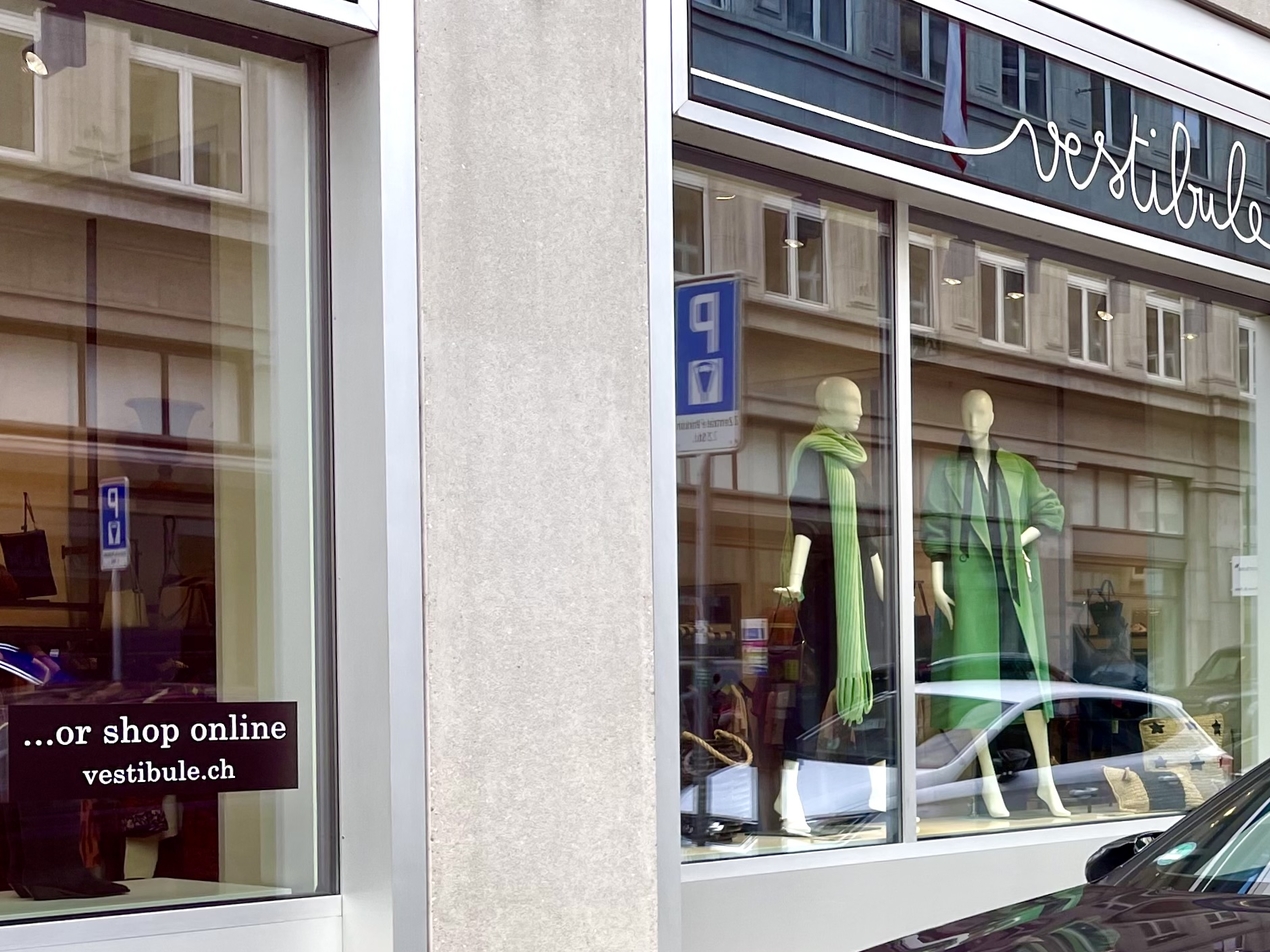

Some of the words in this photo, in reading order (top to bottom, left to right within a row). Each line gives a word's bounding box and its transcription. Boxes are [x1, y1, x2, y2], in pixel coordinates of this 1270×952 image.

[1016, 113, 1265, 244] vestibule
[23, 724, 92, 747] ...or
[103, 715, 180, 749] shop
[190, 713, 287, 742] online
[83, 758, 236, 785] vestibule.ch
